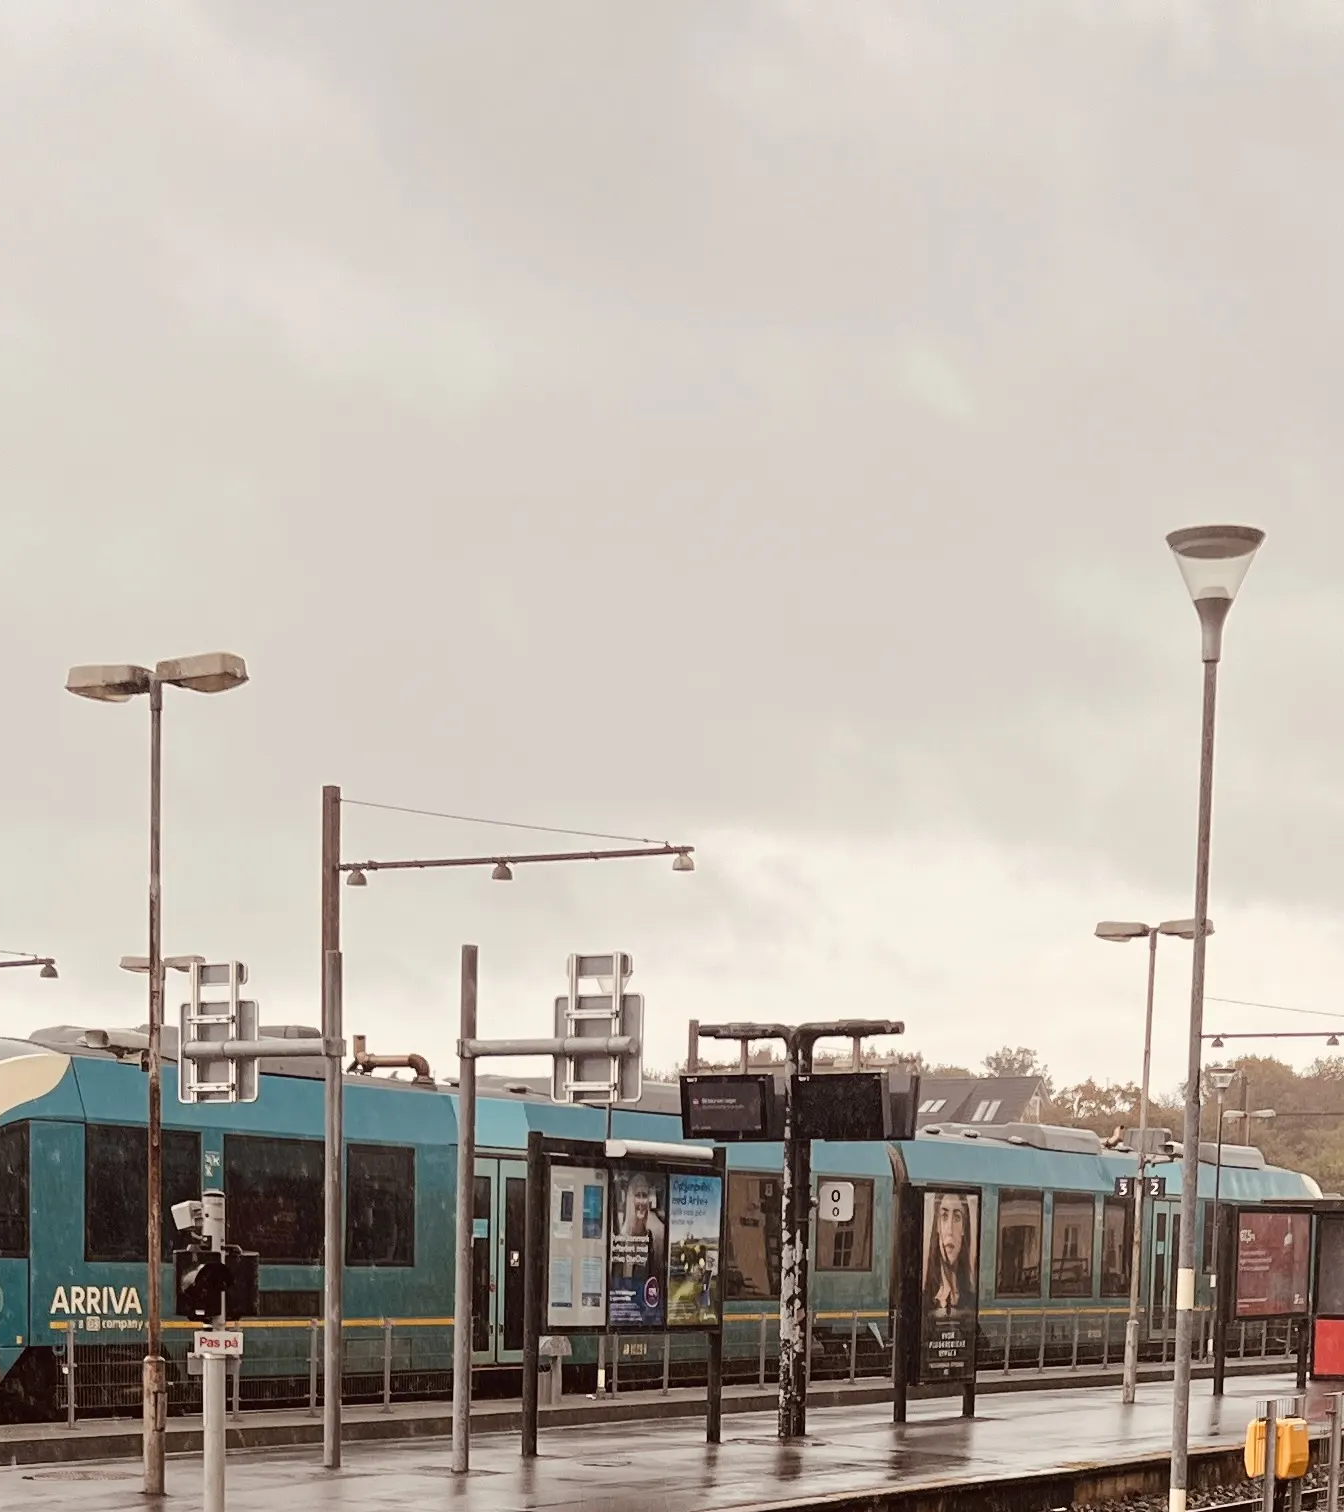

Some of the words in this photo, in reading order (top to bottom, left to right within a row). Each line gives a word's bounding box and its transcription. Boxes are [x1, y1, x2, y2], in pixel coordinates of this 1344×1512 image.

[1119, 1182, 1128, 1196] 3
[1150, 1182, 1159, 1196] 2
[50, 1286, 143, 1315] ARRIVA
[101, 1319, 144, 1332] company
[199, 1336, 221, 1348] Pas
[224, 1335, 239, 1350] på
